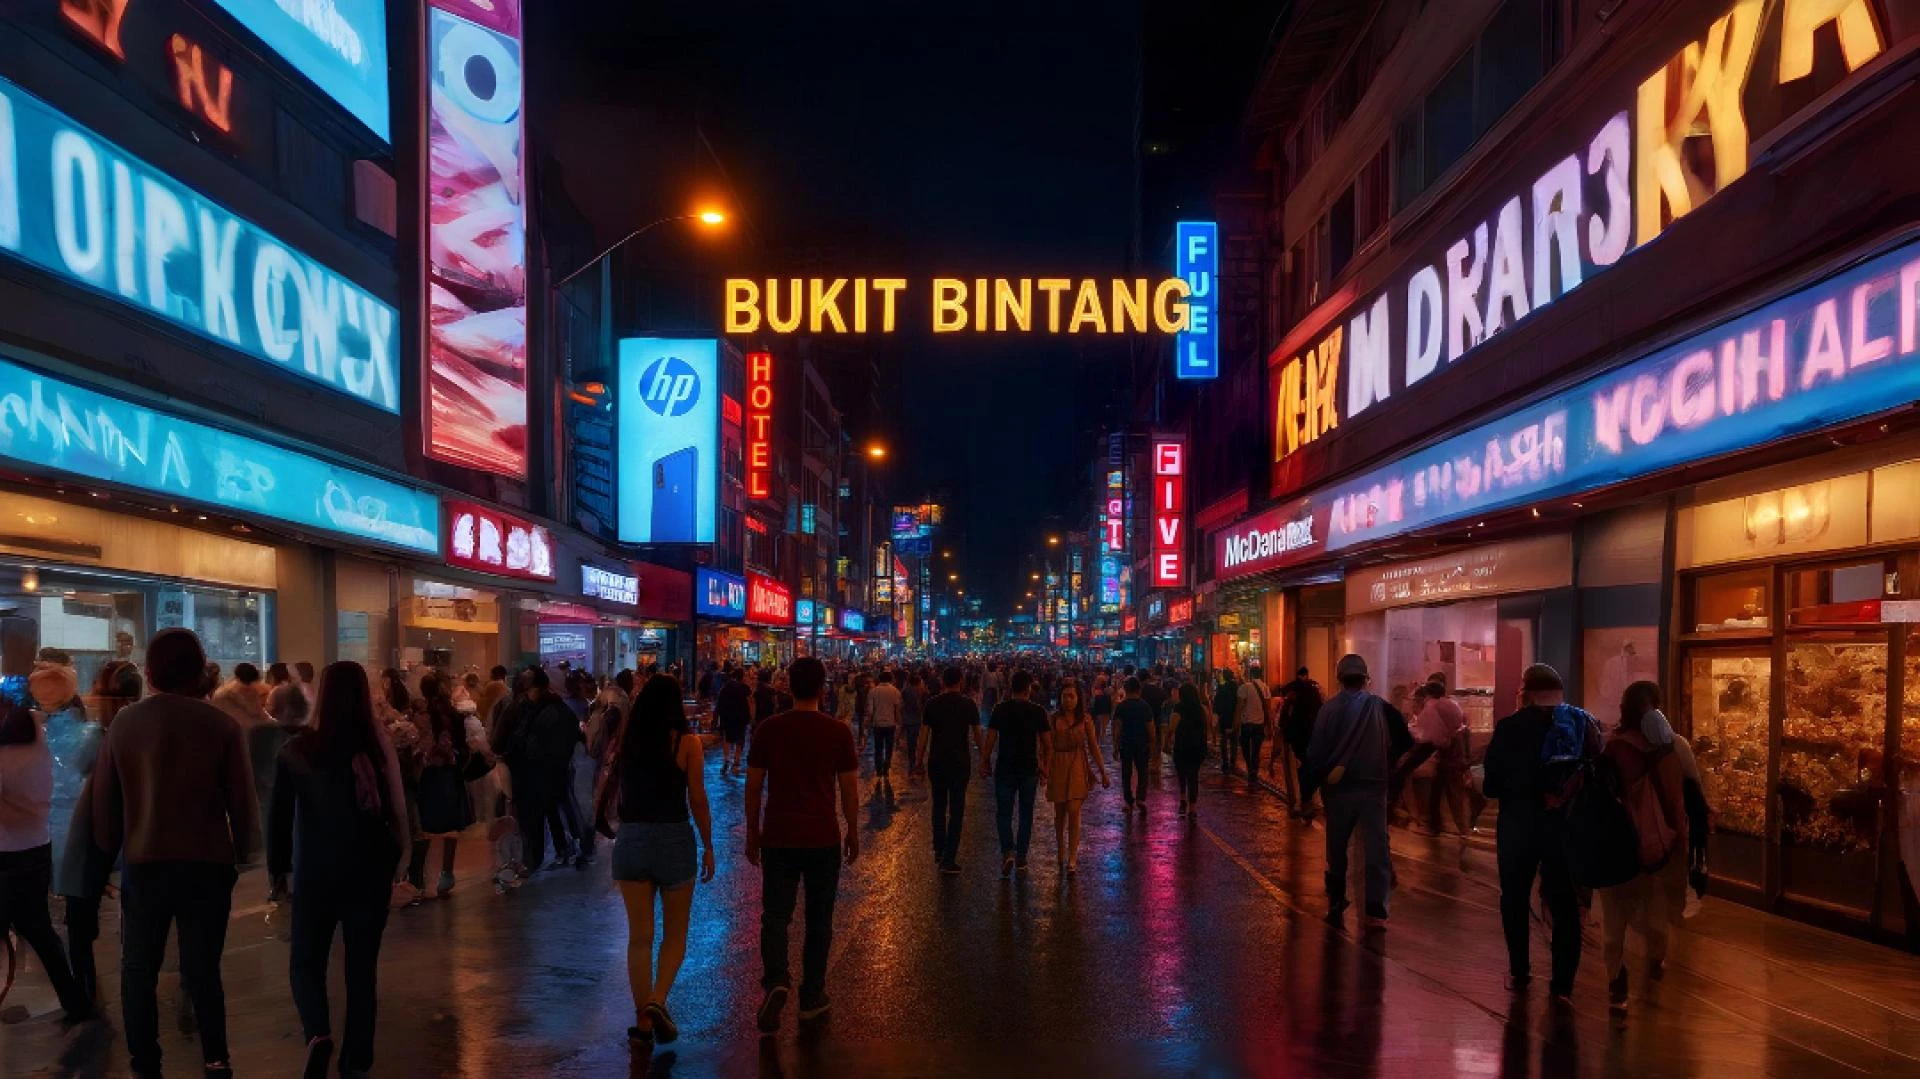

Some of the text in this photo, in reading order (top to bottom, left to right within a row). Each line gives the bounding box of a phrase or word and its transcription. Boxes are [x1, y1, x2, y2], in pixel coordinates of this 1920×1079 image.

[725, 278, 1192, 333] BUKIT BINTANG
[1188, 236, 1210, 367] FUEL
[646, 357, 695, 416] hp
[751, 356, 771, 496] HOTEL
[1156, 444, 1181, 580] FIVE
